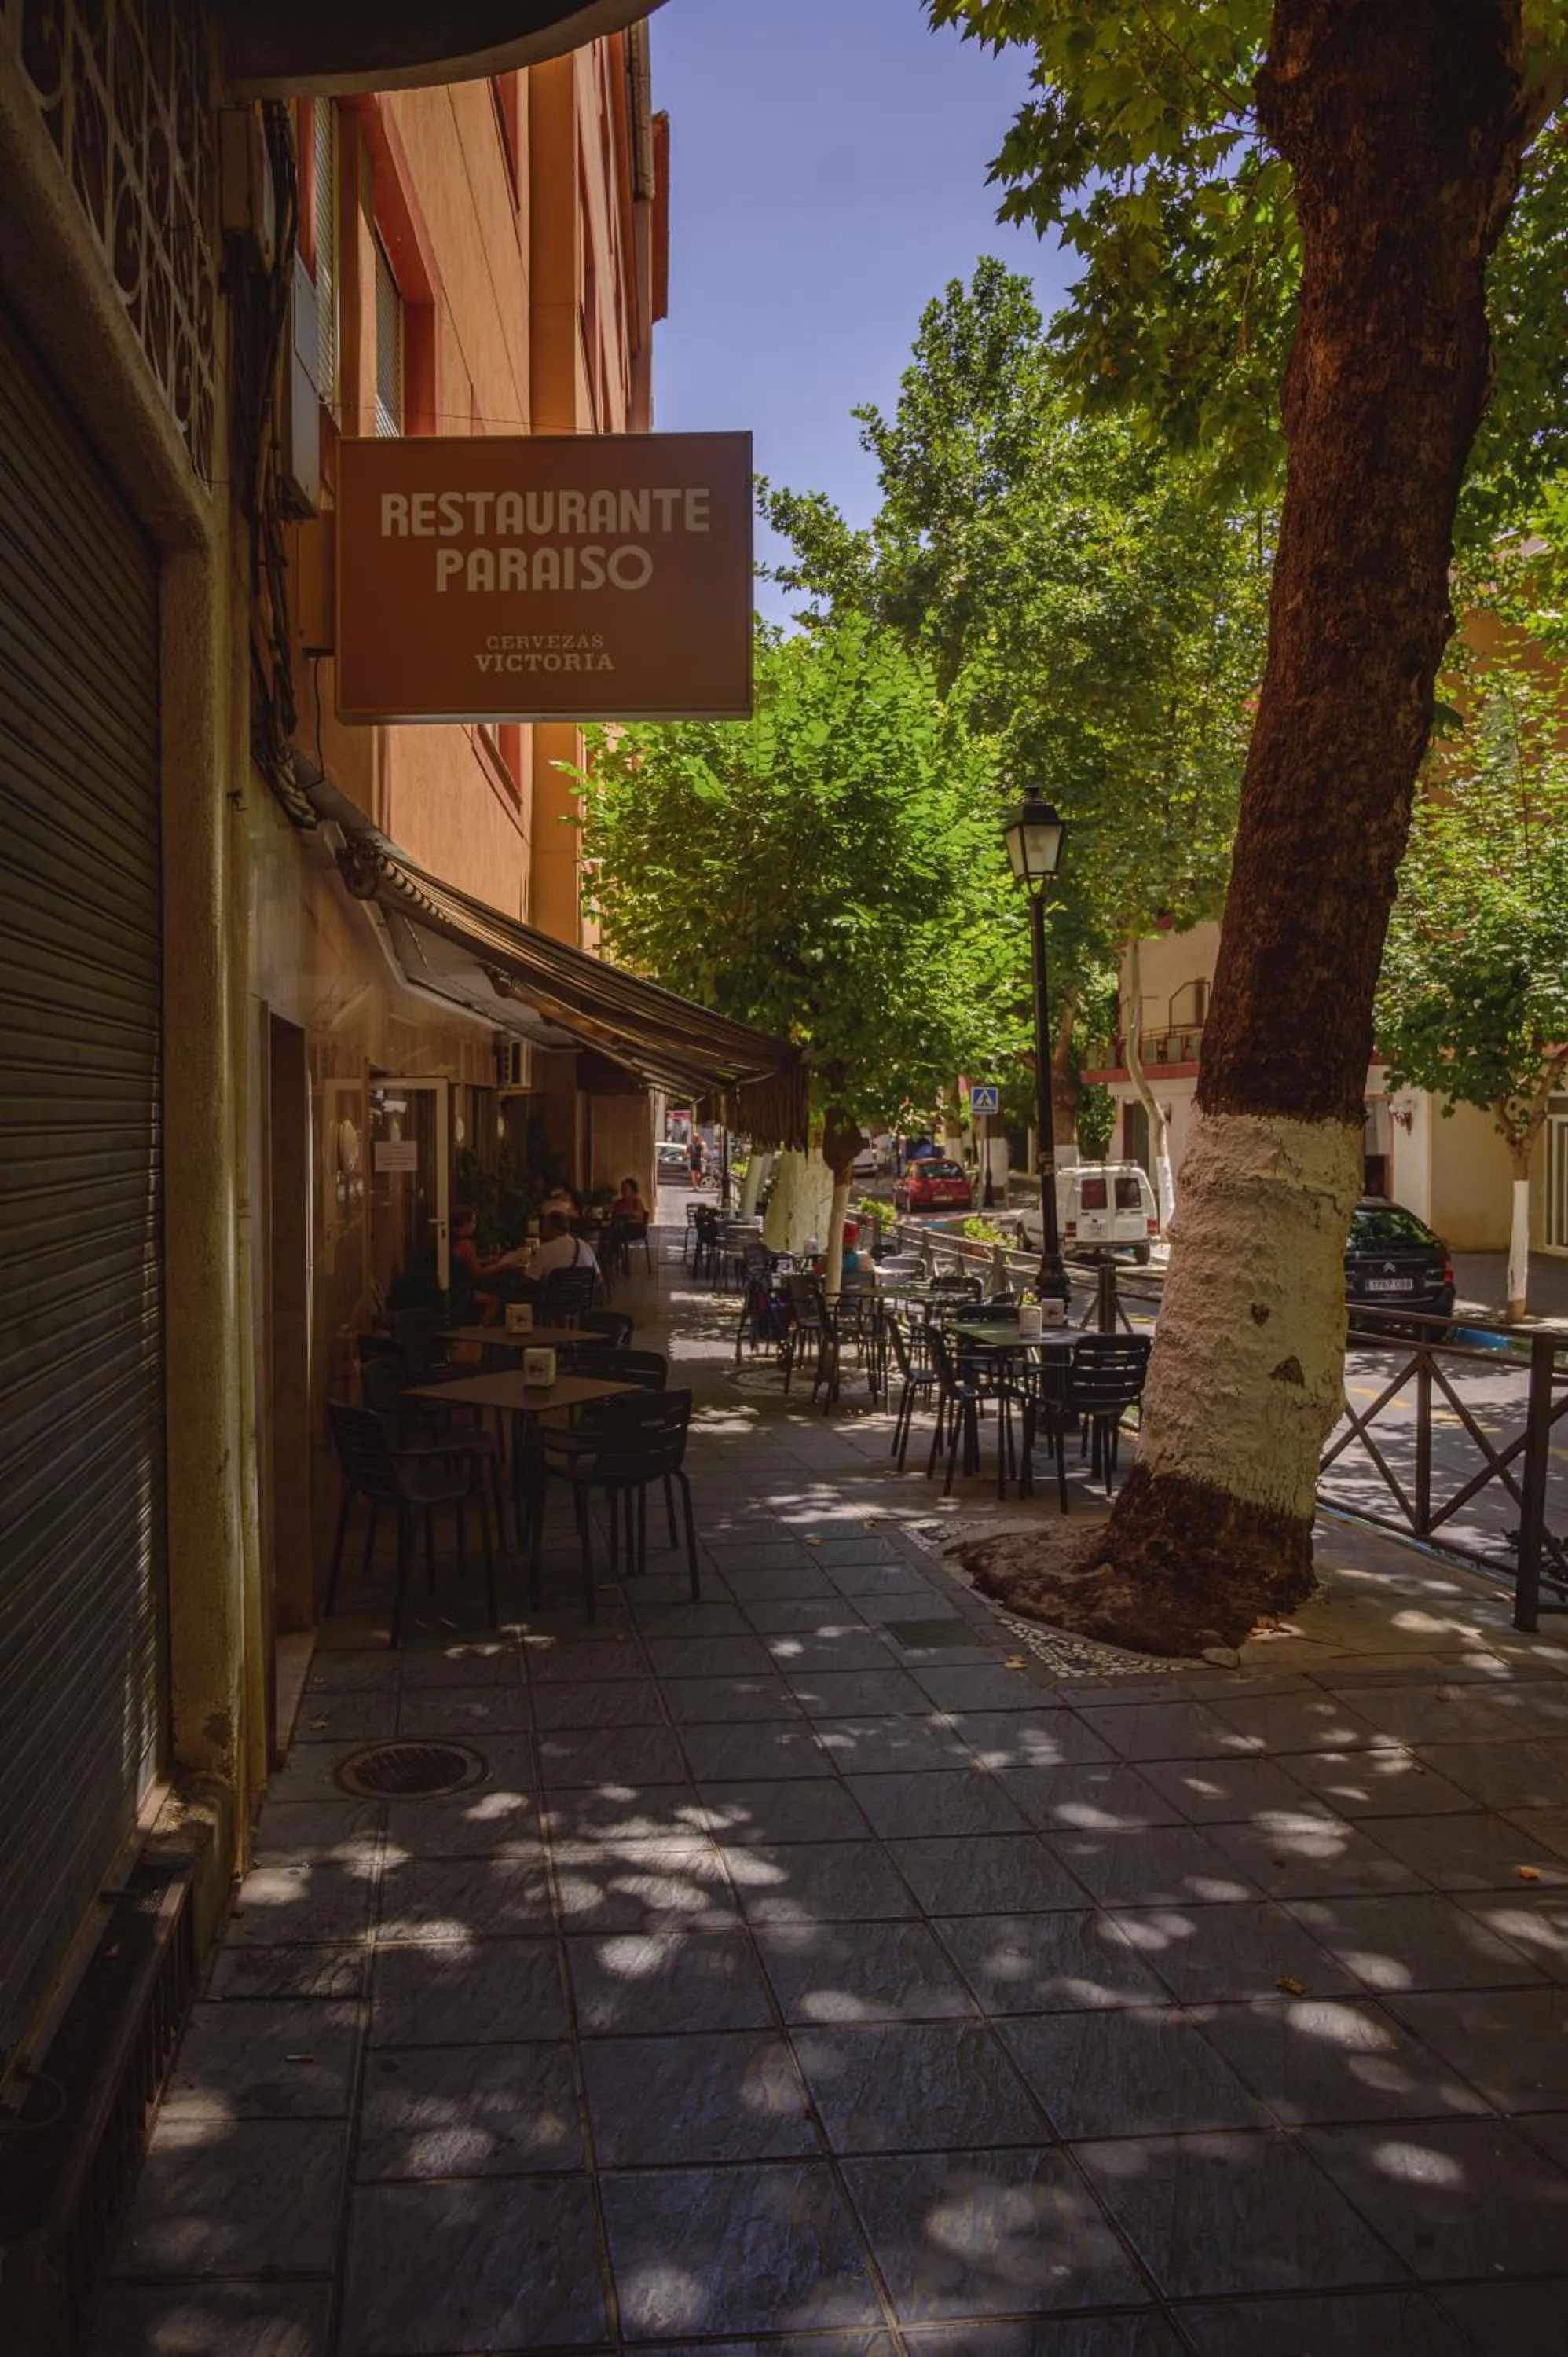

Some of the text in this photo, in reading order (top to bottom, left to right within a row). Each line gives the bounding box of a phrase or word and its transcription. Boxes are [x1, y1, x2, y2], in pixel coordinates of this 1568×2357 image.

[381, 488, 709, 537] RESTAURANTE
[436, 545, 654, 592] PARAISO
[486, 634, 604, 650] CERVEZAS
[475, 653, 616, 672] VICTORIA
